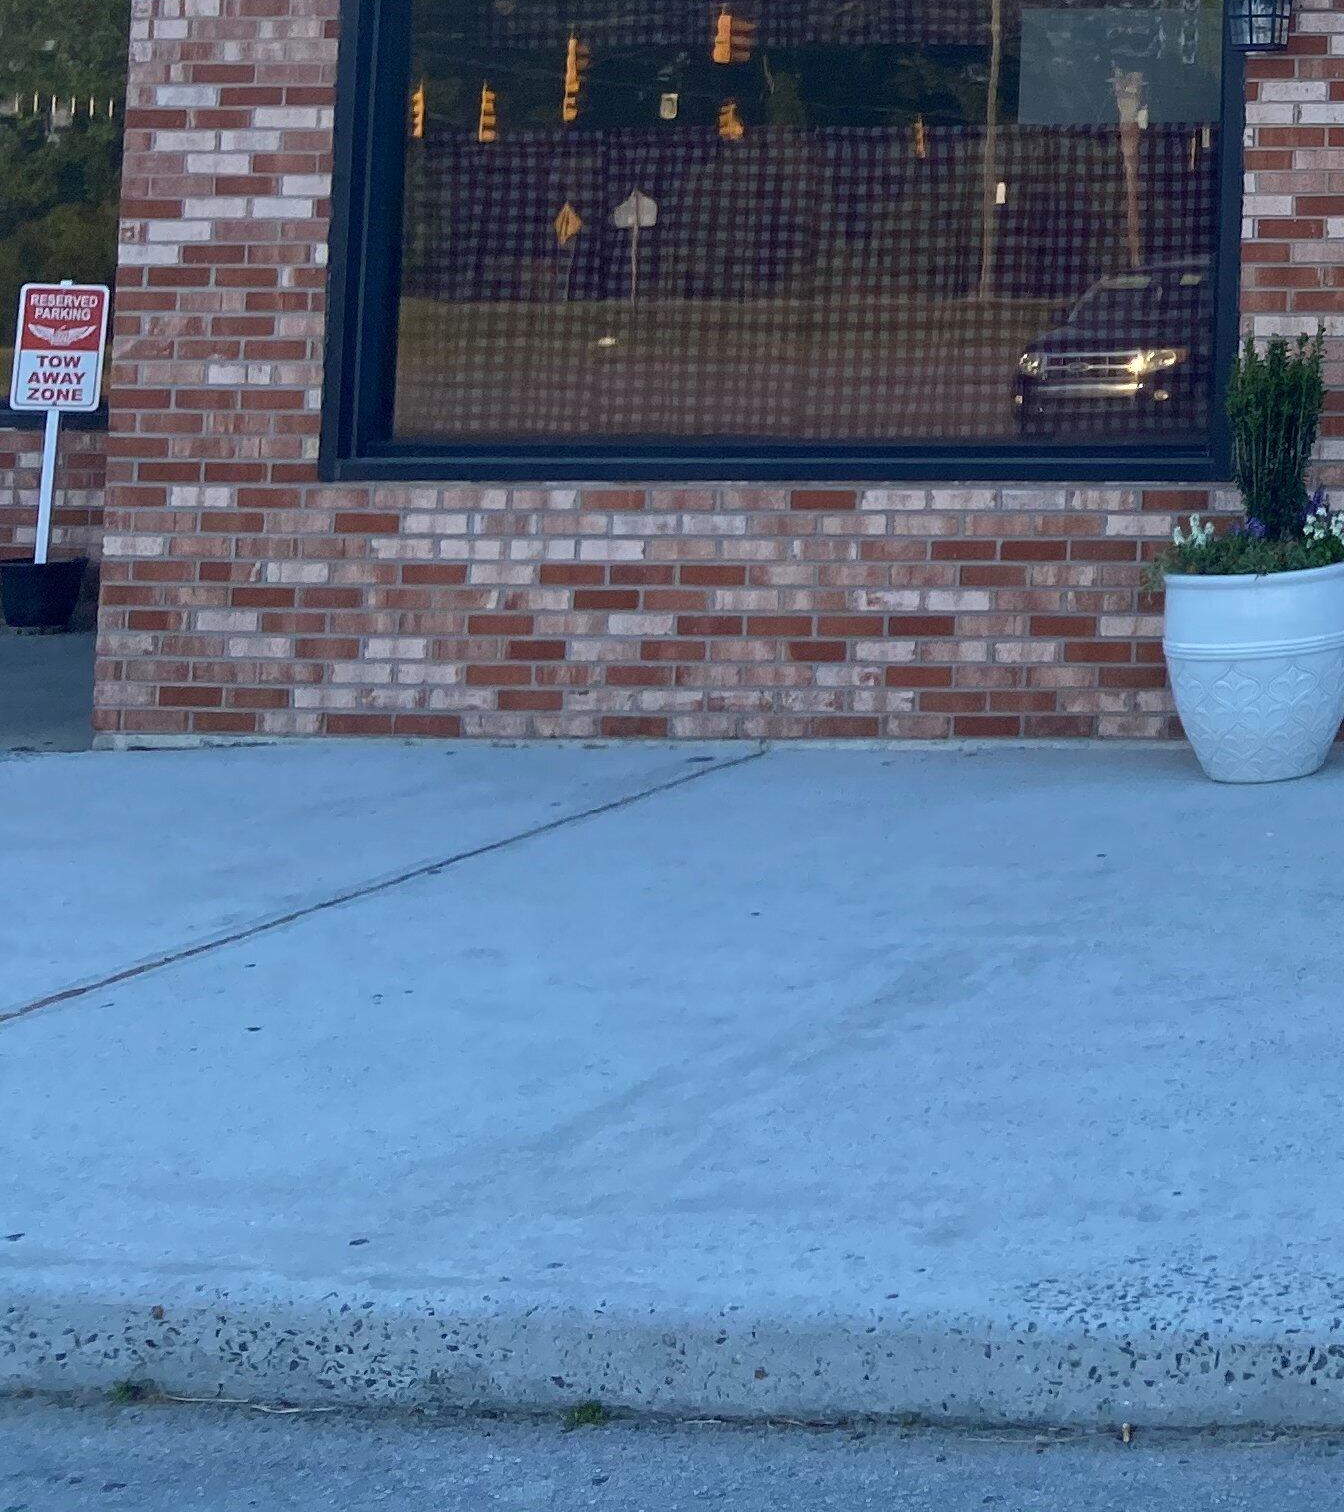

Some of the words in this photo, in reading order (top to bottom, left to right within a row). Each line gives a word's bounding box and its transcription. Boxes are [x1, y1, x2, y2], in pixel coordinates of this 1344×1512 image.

[30, 293, 99, 307] RESERVED
[34, 307, 91, 322] PARKING
[36, 355, 82, 369] TOW
[27, 371, 87, 386] AWAY
[26, 387, 84, 402] ZONE
